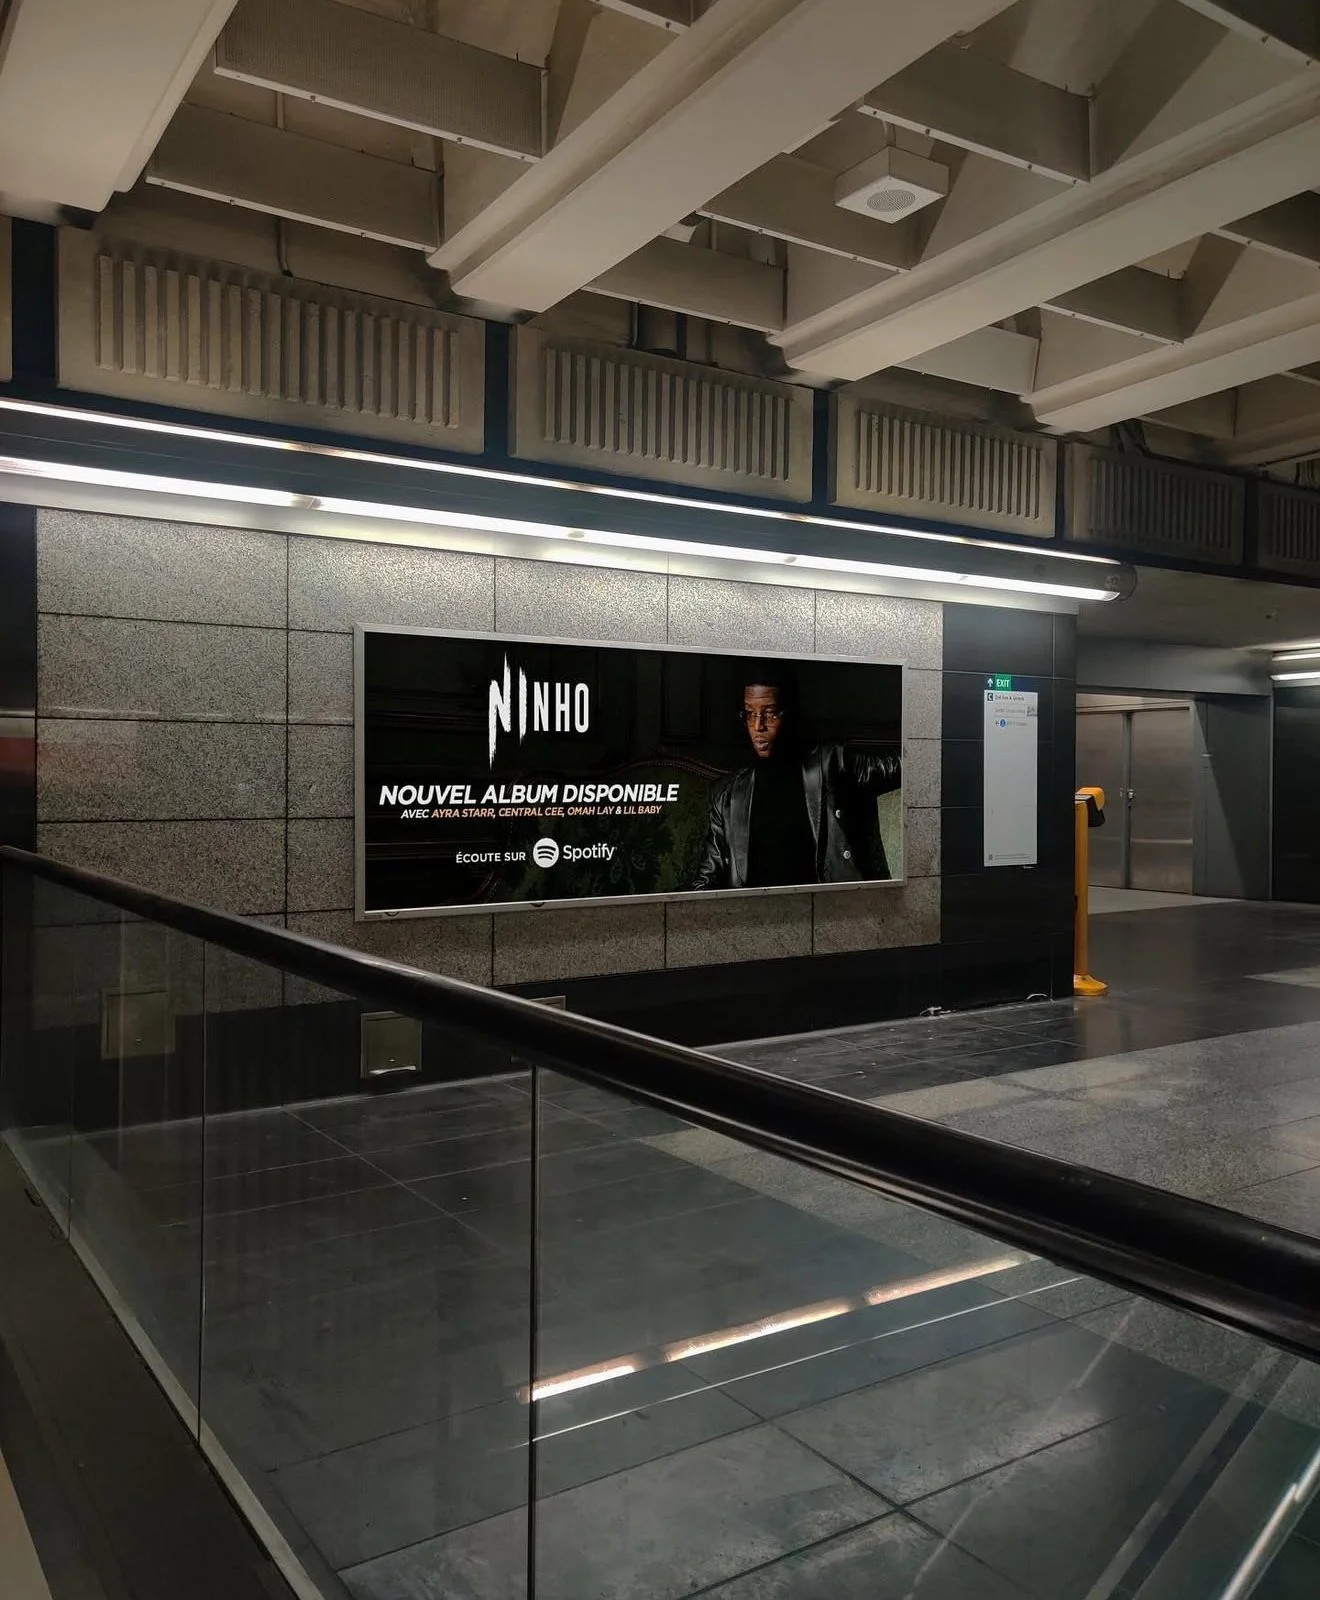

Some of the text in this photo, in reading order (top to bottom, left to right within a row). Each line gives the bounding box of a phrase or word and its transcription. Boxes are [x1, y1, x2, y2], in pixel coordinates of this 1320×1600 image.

[996, 679, 1010, 688] EXIT
[488, 650, 590, 770] NINHO
[379, 783, 680, 806] NOUVEL ALBUM DISPONIBLE
[400, 804, 663, 819] AVEC AYRA STARR, CENTRAL CEE, OMAH LAY & LIL BABY
[455, 842, 615, 864] ÉCOUTE SUR Spotify
